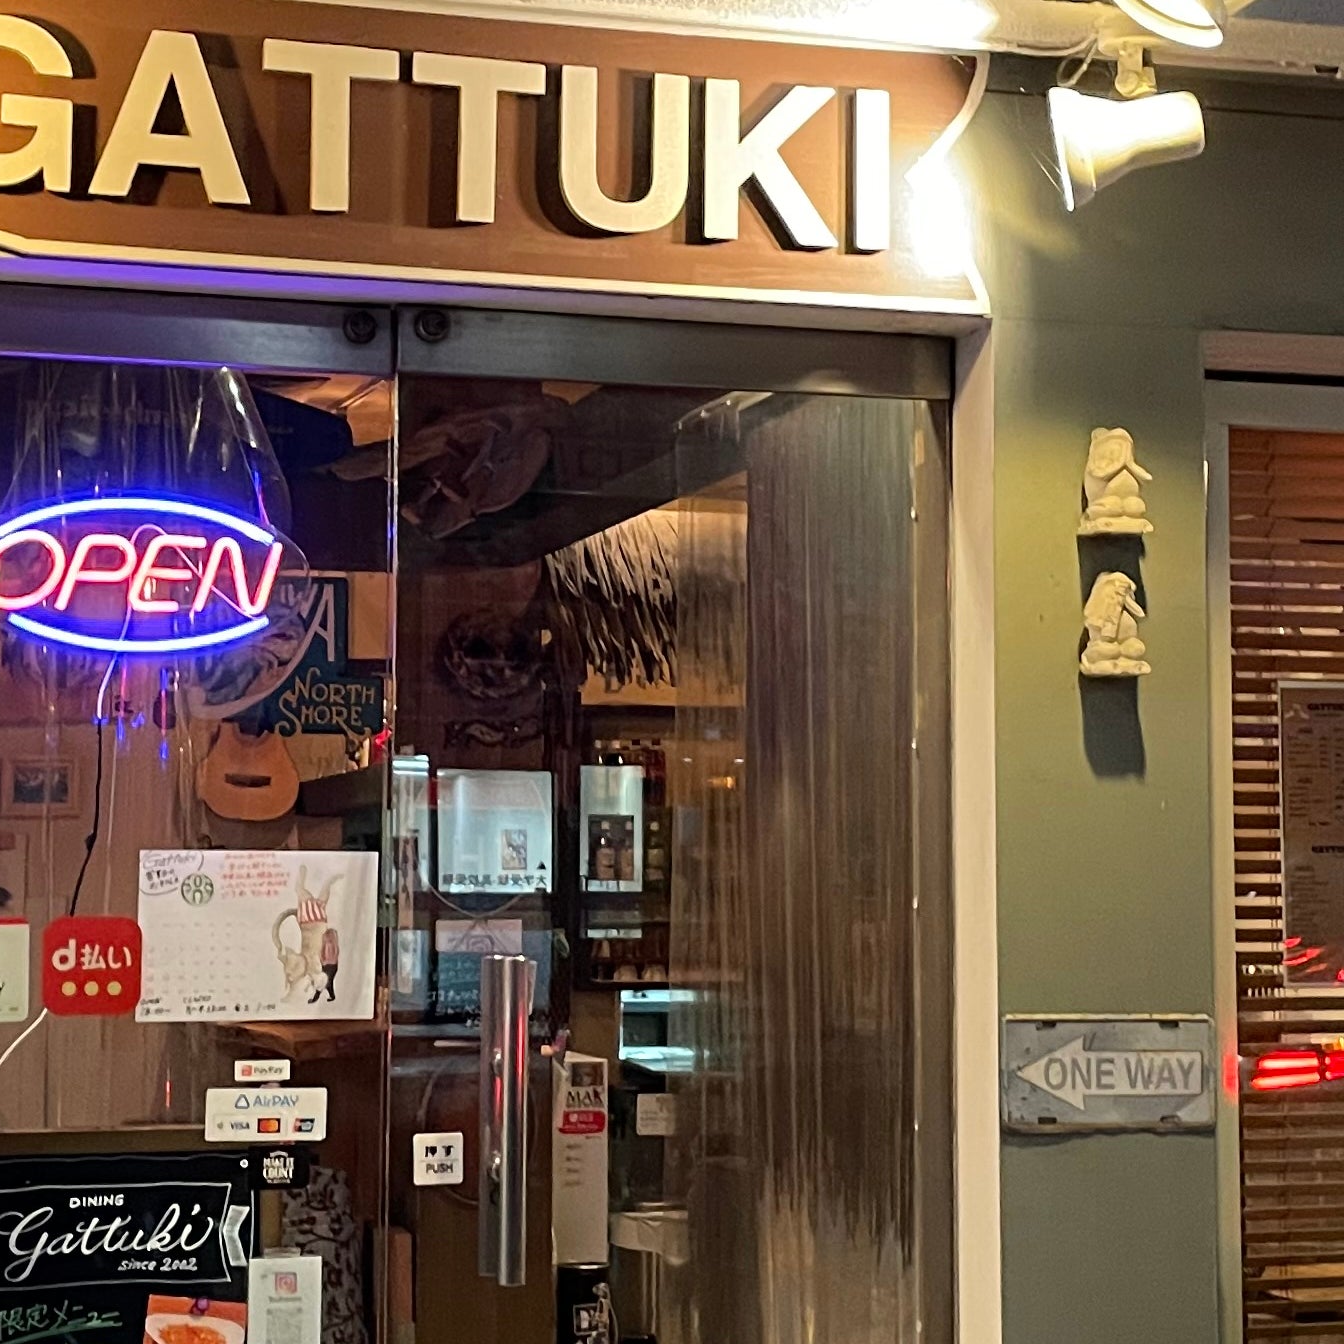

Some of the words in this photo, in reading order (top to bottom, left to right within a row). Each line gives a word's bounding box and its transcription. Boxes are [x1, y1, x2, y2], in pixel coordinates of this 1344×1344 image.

[290, 667, 376, 707] NORTH
[274, 690, 371, 742] SHORE
[51, 938, 132, 971] d払い
[254, 1066, 284, 1075] PayPay
[1043, 1057, 1116, 1090] ONE
[1124, 1057, 1195, 1090] WAY
[425, 1163, 454, 1174] PUSH
[69, 1194, 125, 1209] DINING
[117, 1258, 156, 1272] since
[159, 1257, 199, 1272] 2002
